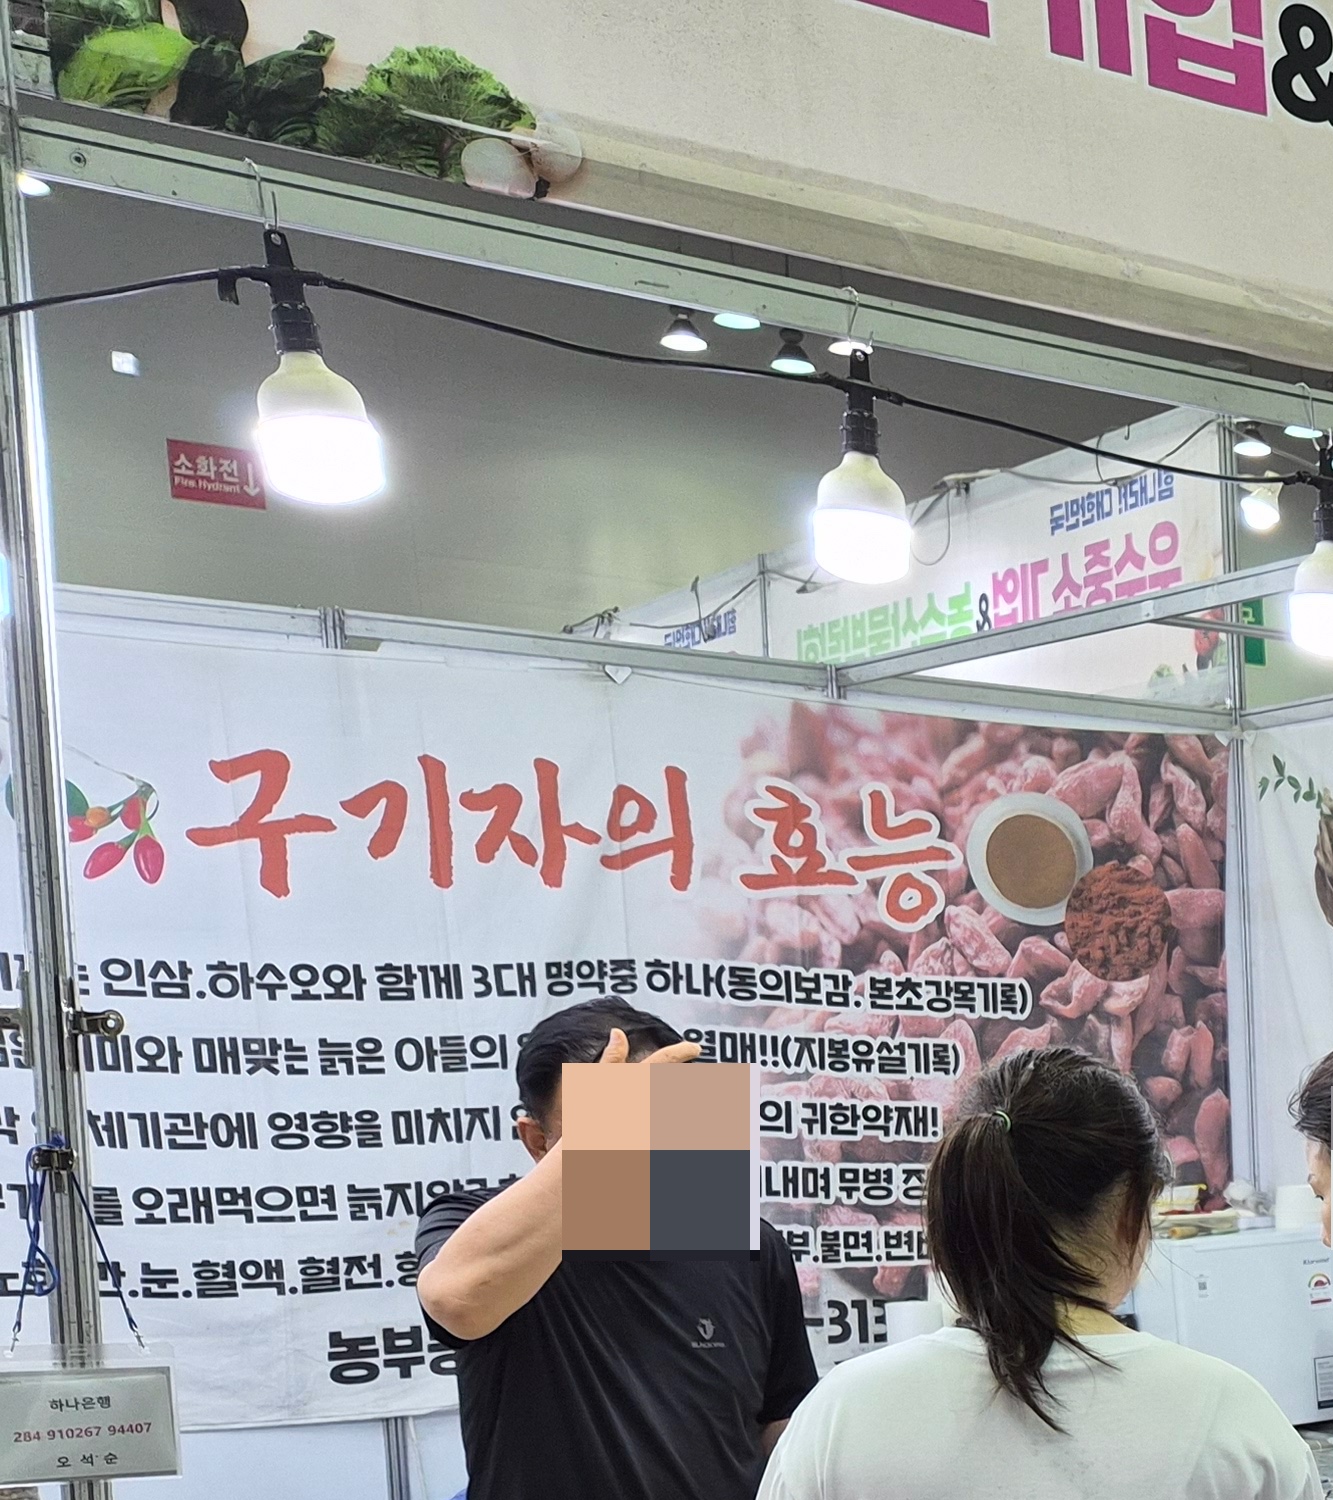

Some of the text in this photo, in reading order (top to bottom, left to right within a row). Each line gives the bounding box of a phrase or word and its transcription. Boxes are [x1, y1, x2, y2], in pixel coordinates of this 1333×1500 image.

[173, 453, 240, 482] 소화전
[186, 748, 956, 924] 구기자의 효능
[375, 963, 462, 1000] 함께
[474, 963, 537, 998] 3대
[545, 960, 638, 998] 명약중
[84, 1035, 182, 1074] 미와
[194, 1036, 307, 1076] 매맞는
[319, 1039, 385, 1076] 늙은
[394, 1035, 509, 1072] 아들의
[270, 1111, 382, 1150] 영향을
[392, 1108, 499, 1146] 미치지
[801, 1102, 938, 1138] 귀한약재!
[839, 1167, 893, 1200] 무병
[132, 1184, 338, 1225] 오래먹으면
[49, 1396, 111, 1411] 하나은행
[47, 1423, 151, 1440] 910267 94407
